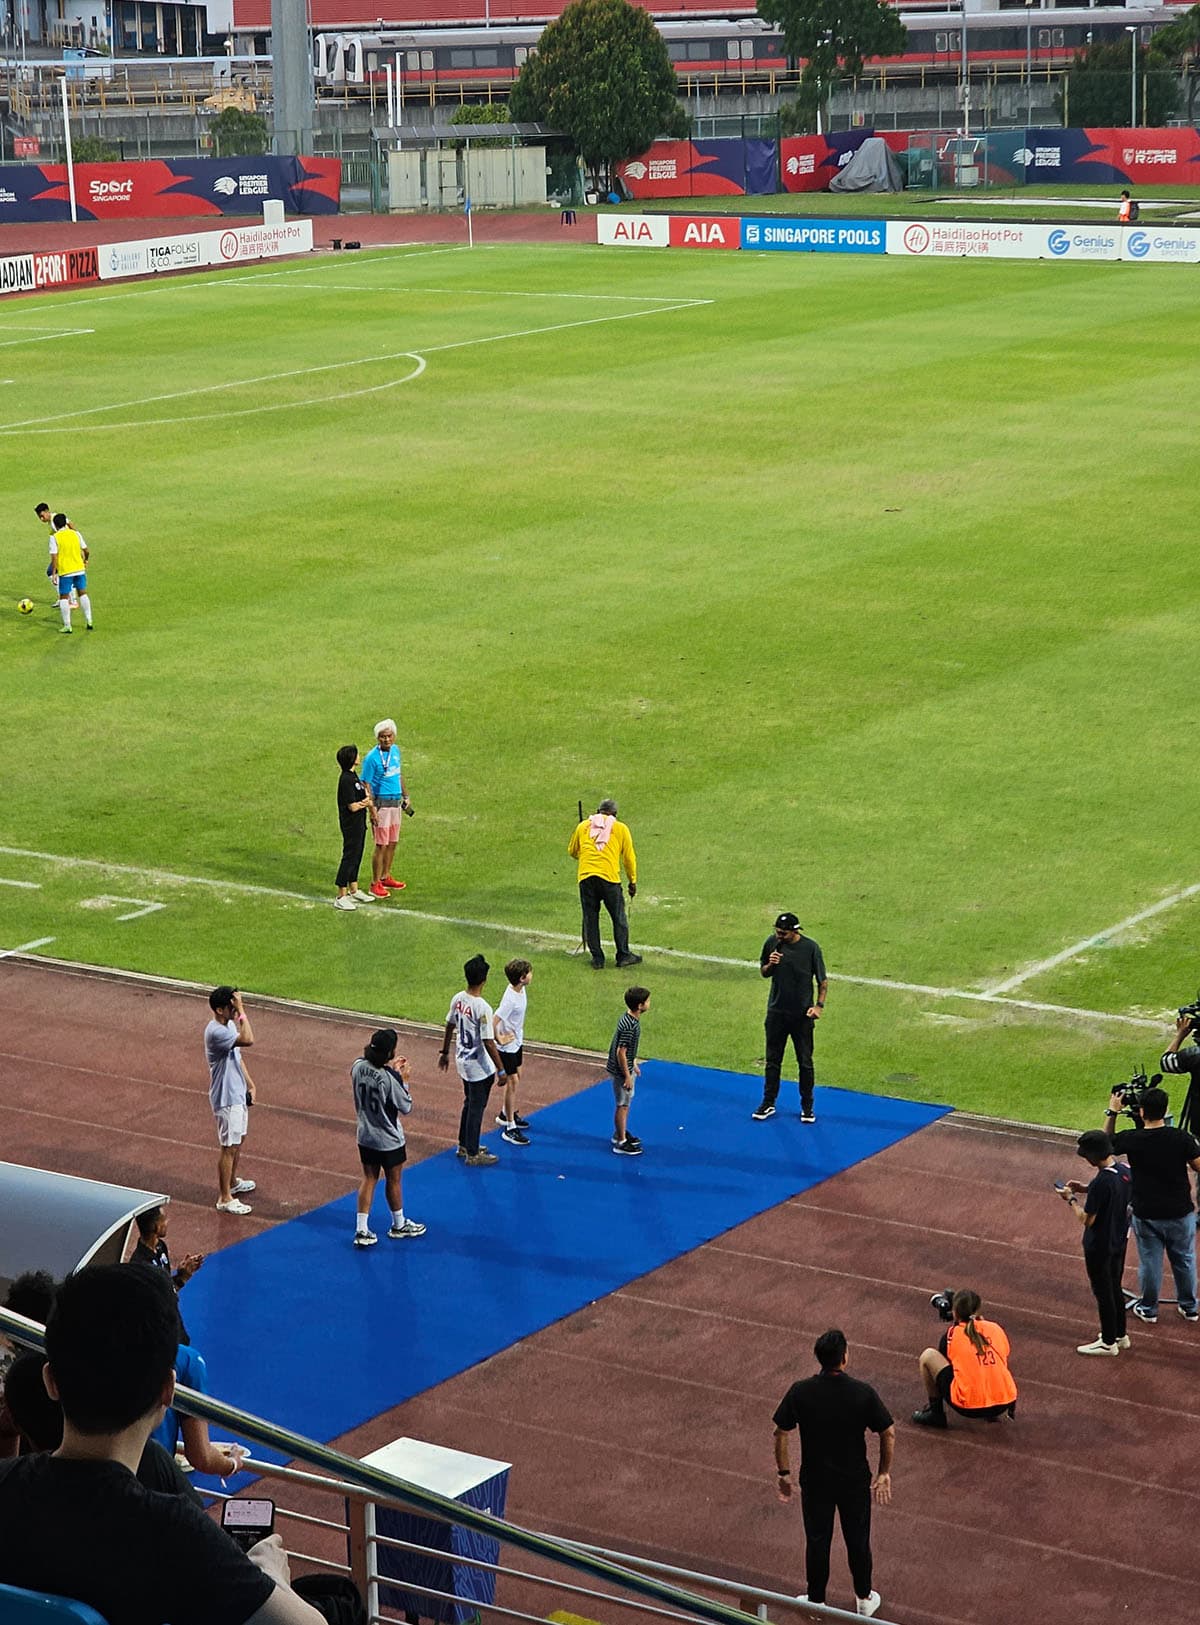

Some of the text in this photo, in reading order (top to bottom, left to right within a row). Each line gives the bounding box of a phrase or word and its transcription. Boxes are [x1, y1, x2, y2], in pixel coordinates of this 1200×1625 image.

[649, 170, 677, 180] LEAGUE
[92, 194, 131, 202] SINGAPORE
[239, 186, 269, 195] LEAGUE
[239, 227, 301, 244] Haidilao Hot Pot
[614, 222, 653, 241] AIA
[684, 223, 726, 243] AIA
[764, 227, 881, 246] SINGAPORE POOLS
[932, 228, 1023, 242] Haidilao Hot Pot
[1073, 235, 1115, 248] Genius
[1153, 237, 1197, 251] Genius
[68, 250, 98, 279] PIZZA
[455, 1001, 473, 1018] AIA
